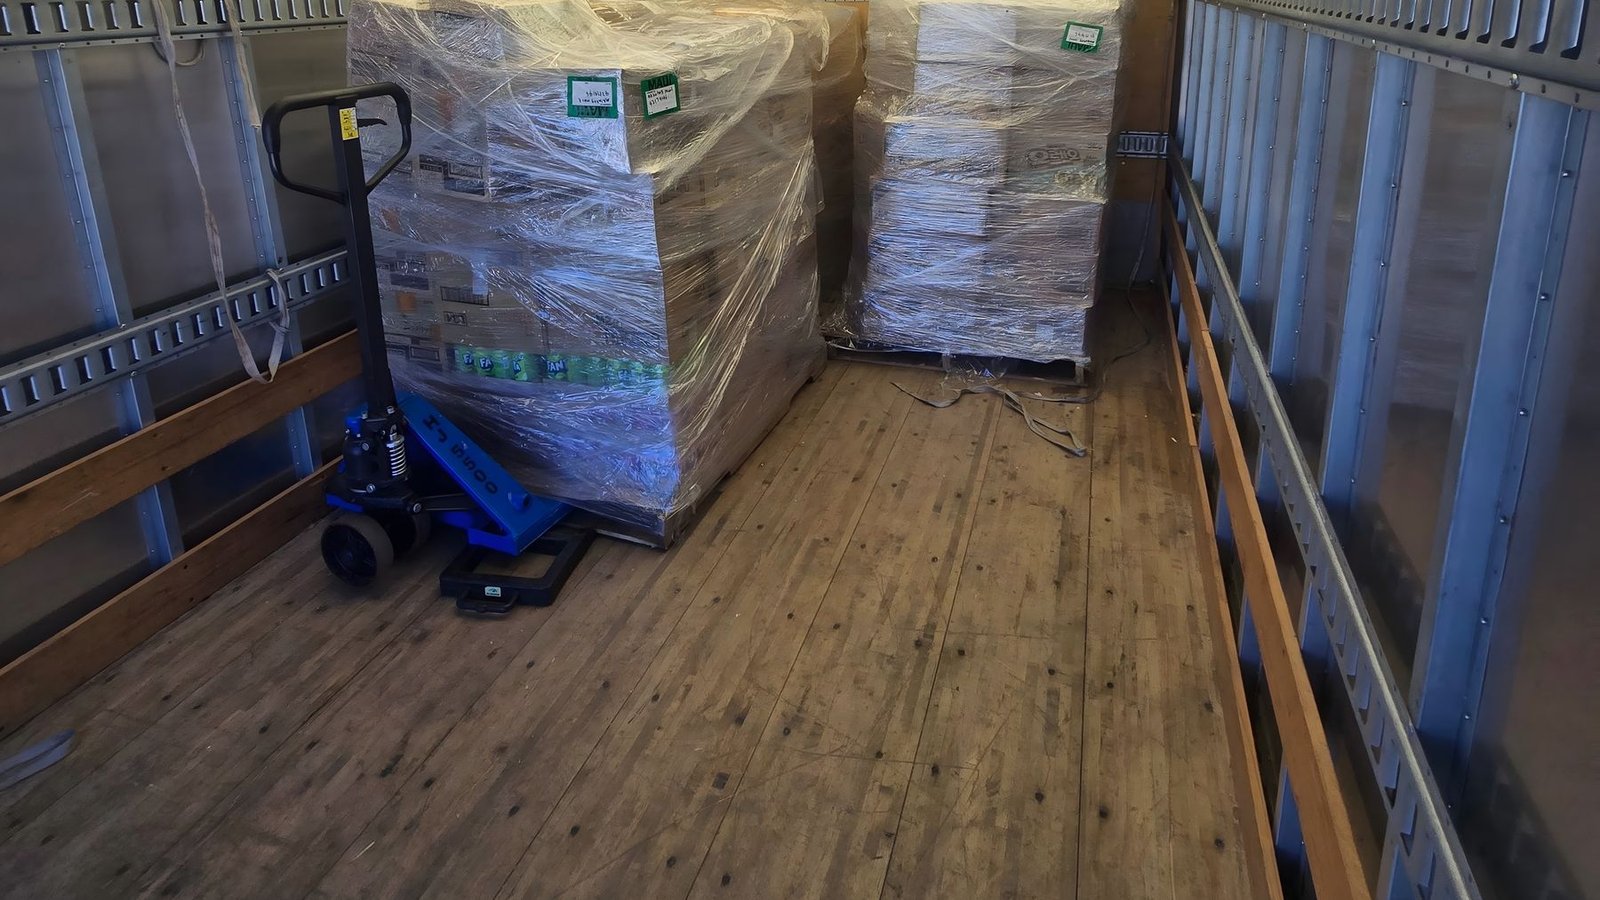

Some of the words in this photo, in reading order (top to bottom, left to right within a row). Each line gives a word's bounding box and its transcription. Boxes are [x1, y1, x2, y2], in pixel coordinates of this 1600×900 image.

[648, 75, 673, 90] MAUI
[422, 415, 448, 443] HJ
[451, 444, 498, 494] 5500
